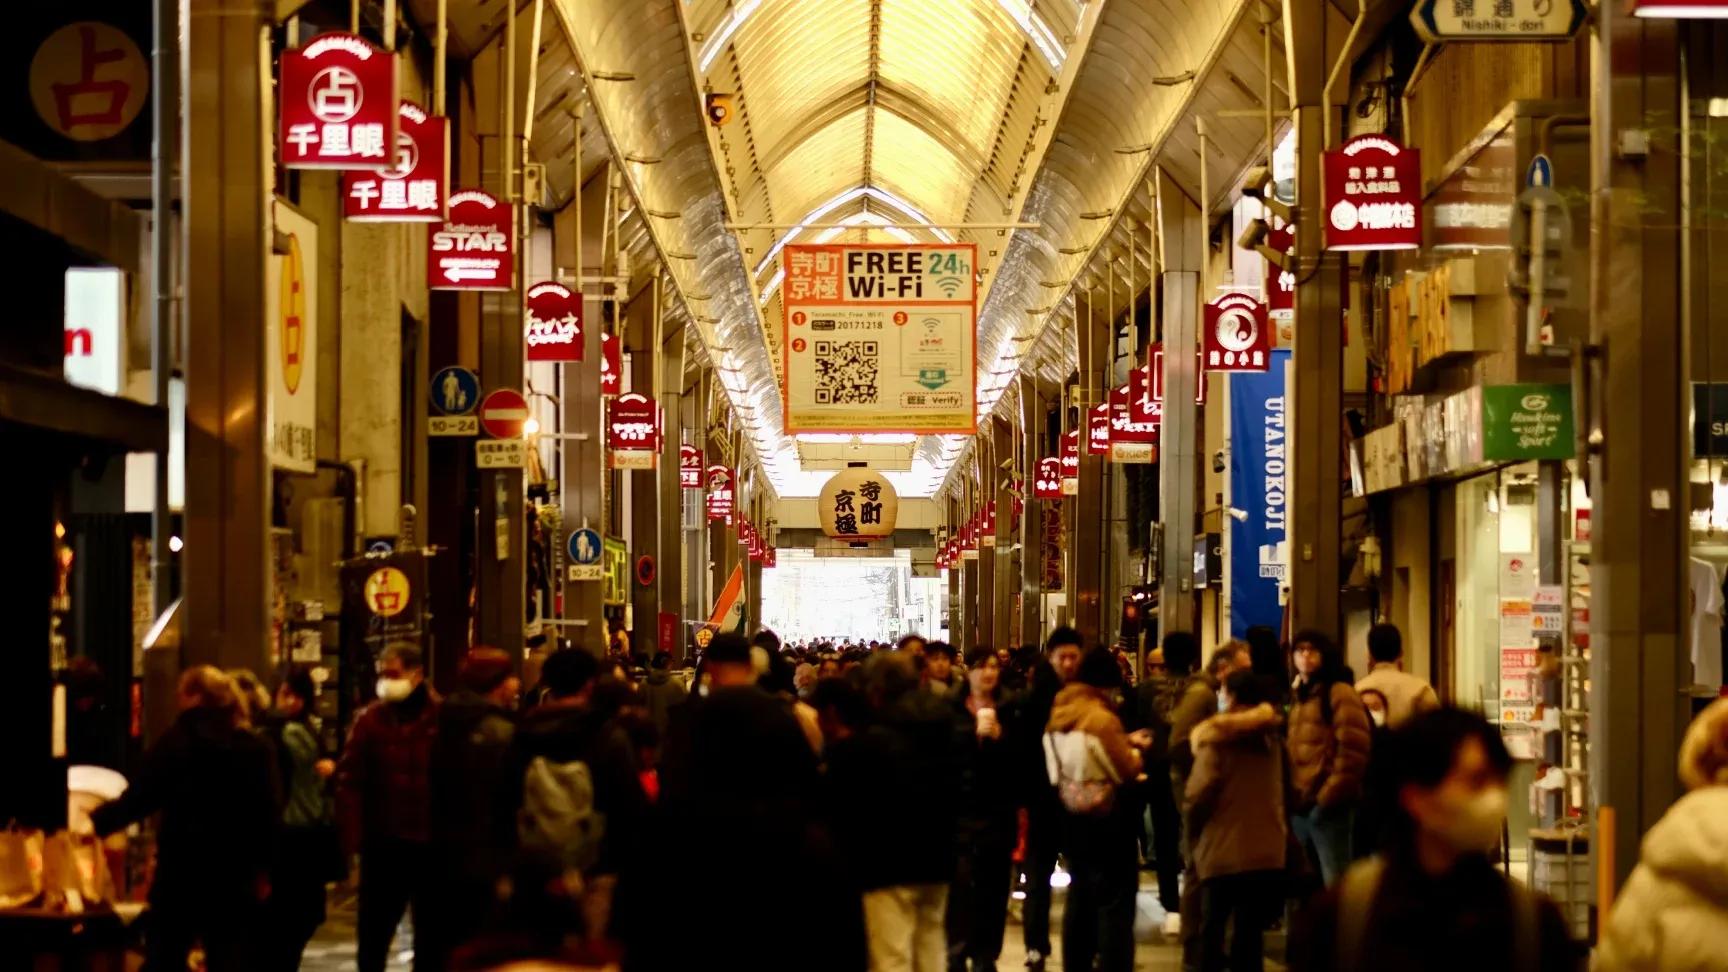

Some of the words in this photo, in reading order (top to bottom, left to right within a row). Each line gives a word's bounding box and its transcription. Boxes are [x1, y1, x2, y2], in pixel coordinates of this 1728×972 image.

[51, 26, 130, 131] 占
[316, 67, 357, 116] 占
[287, 123, 384, 156] 千里眼
[350, 179, 438, 210] 千里眼
[432, 232, 507, 252] STAR
[791, 251, 841, 275] 寺町
[848, 252, 922, 274] FREE
[929, 253, 970, 275] 24h
[789, 276, 838, 300] 京極
[848, 276, 922, 298] Wi-Fi
[838, 321, 883, 330] 20171218
[932, 396, 959, 406] Verify
[1264, 395, 1285, 531] UTANOKOJI
[834, 489, 859, 534] 京極
[859, 481, 883, 524] 寺町
